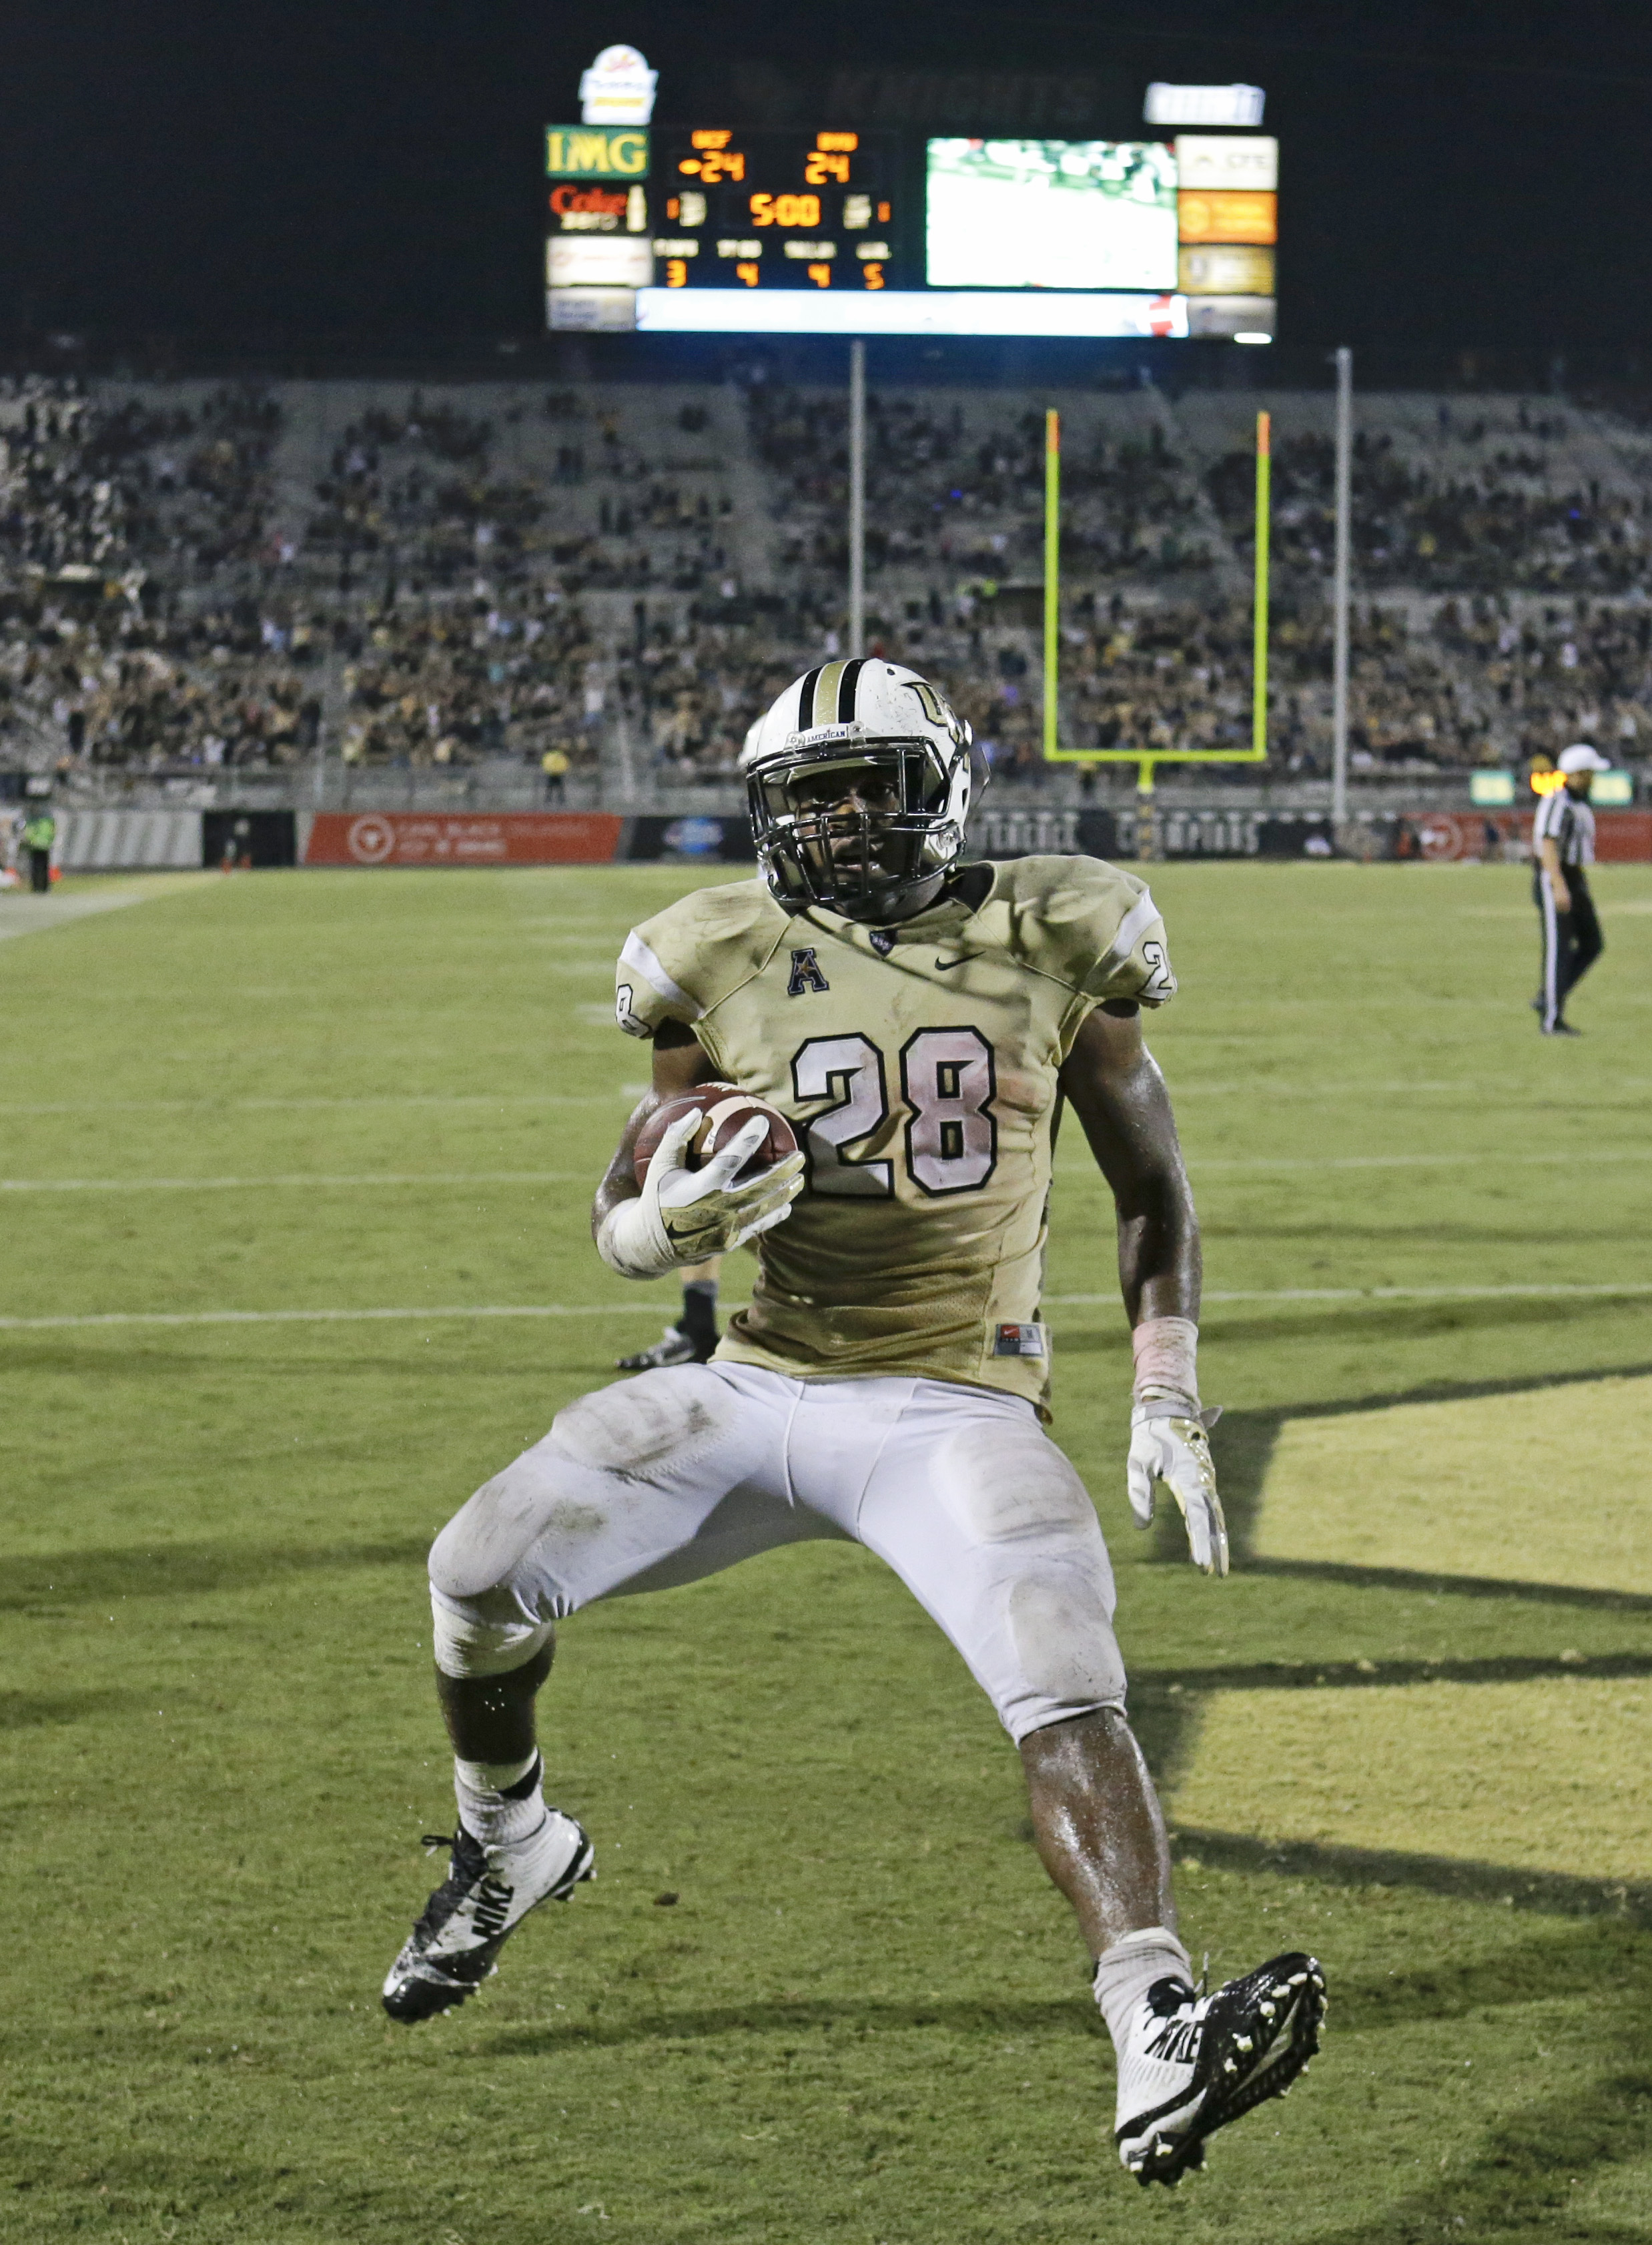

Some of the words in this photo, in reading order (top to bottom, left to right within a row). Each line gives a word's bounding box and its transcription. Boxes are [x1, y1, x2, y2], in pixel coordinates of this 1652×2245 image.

[548, 132, 647, 173] IMG
[805, 151, 849, 184] 24
[807, 730, 846, 743] AMERICAN
[1134, 941, 1173, 1001] 2
[791, 1025, 997, 1201] 28
